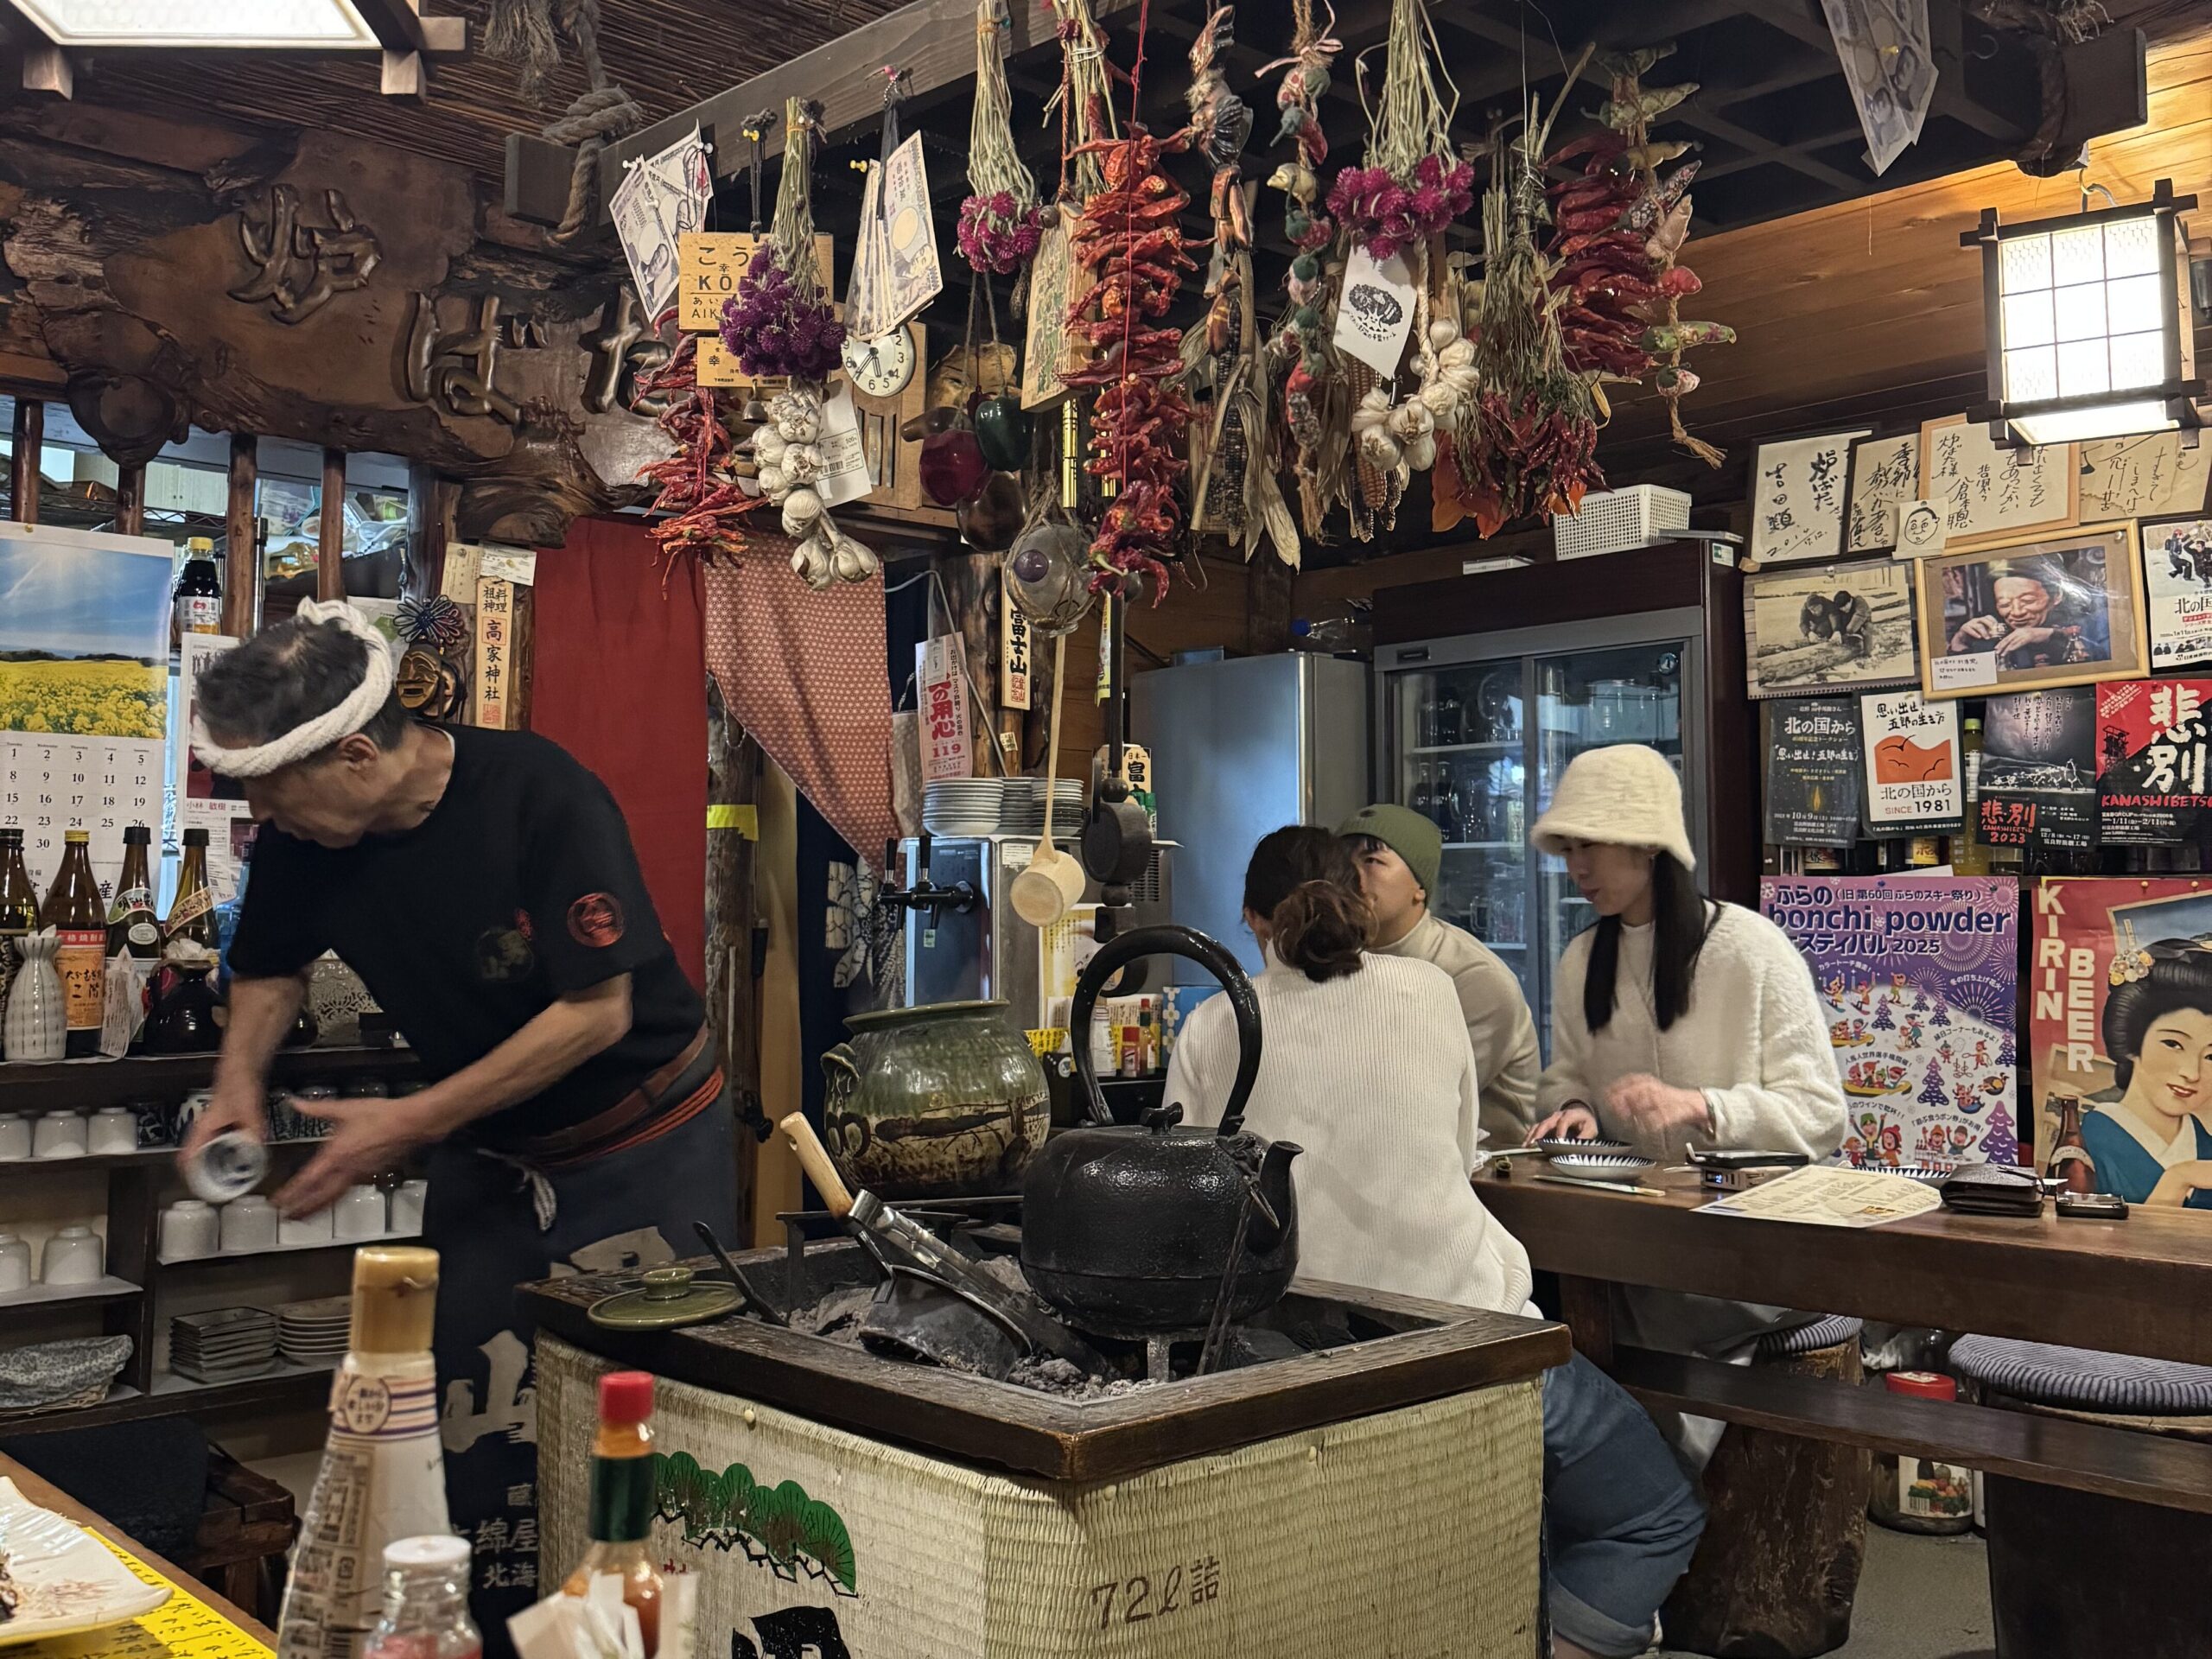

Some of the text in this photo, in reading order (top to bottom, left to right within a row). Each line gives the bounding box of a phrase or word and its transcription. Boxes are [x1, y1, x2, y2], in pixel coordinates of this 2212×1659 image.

[698, 245, 750, 267] こう
[692, 296, 719, 305] あい
[691, 308, 723, 319] AIK
[482, 585, 495, 613] 祖神
[495, 587, 508, 613] 料理
[1009, 608, 1028, 677] 富士山
[484, 619, 503, 702] 高家神社
[1784, 716, 1856, 735] 北の国から
[1888, 712, 1946, 732] 五郎の生き方
[2141, 683, 2208, 795] 悲別
[11, 748, 16, 757] 1
[43, 750, 51, 760] 2
[76, 751, 82, 760] 3
[932, 744, 962, 759] 119
[107, 753, 114, 762] 4
[137, 754, 144, 764] 5
[10, 771, 17, 780] 8
[43, 772, 50, 781] 9
[73, 772, 85, 783] 10
[104, 774, 116, 784] 11
[135, 776, 147, 785] 12
[1880, 783, 1953, 800] 北の国から
[7, 793, 19, 803] 15
[40, 794, 52, 804] 16
[72, 795, 83, 804] 17
[103, 797, 115, 806] 18
[133, 798, 145, 807] 19
[1885, 799, 1951, 816] SINCE 1981
[4, 816, 18, 825] 22
[38, 817, 51, 826] 23
[69, 817, 82, 827] 24
[101, 818, 114, 828] 25
[132, 819, 145, 828] 26
[1990, 832, 2026, 844] 2023
[36, 838, 50, 849] 30
[1776, 884, 1834, 907] ふらの
[1858, 888, 1893, 900] 第60回
[1769, 904, 2012, 936] bonchi powder
[1789, 932, 1942, 956] スティバル 2025
[2036, 884, 2095, 1073] KIRIN BEER
